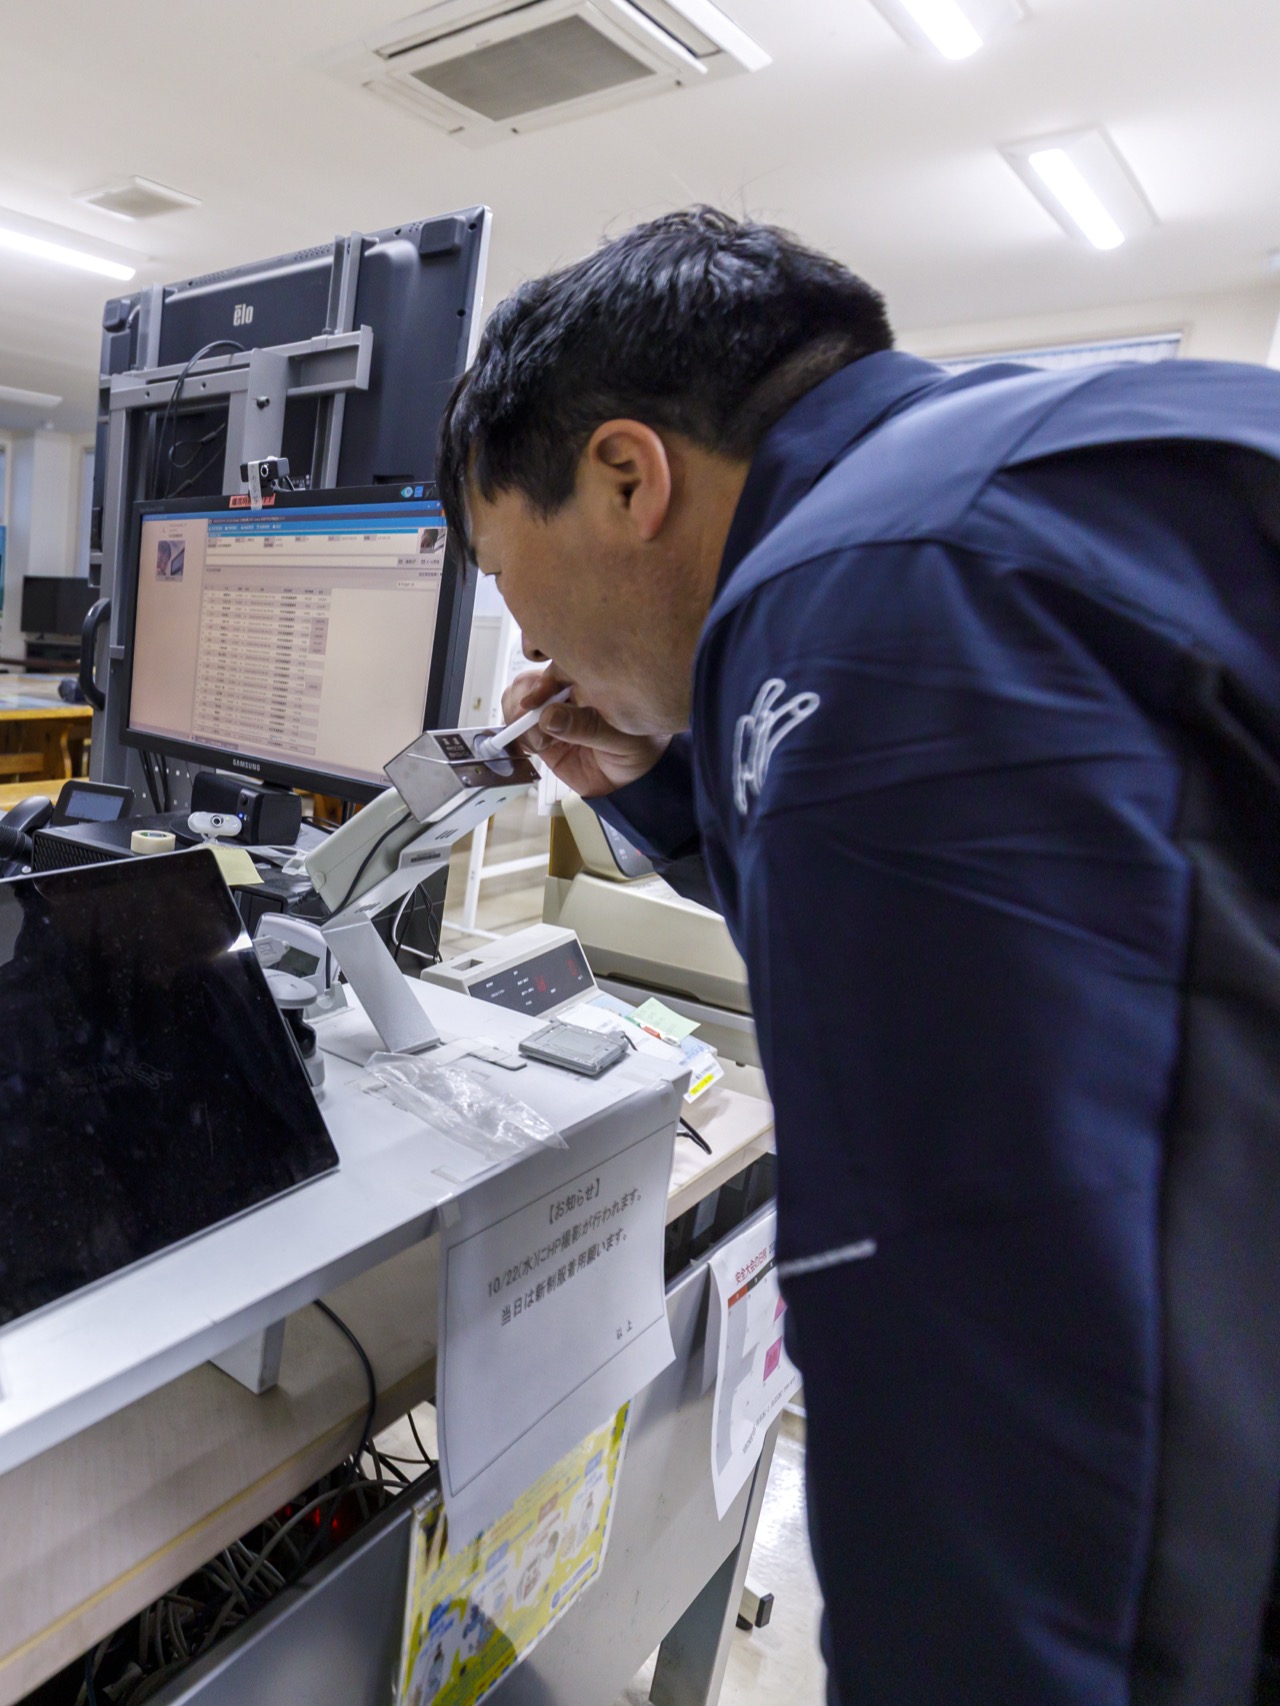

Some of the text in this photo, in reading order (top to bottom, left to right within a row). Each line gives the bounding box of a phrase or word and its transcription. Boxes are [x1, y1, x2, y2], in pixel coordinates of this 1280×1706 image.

[232, 758, 261, 772] SAMSUNG
[548, 1177, 601, 1225] 【お知らせ】
